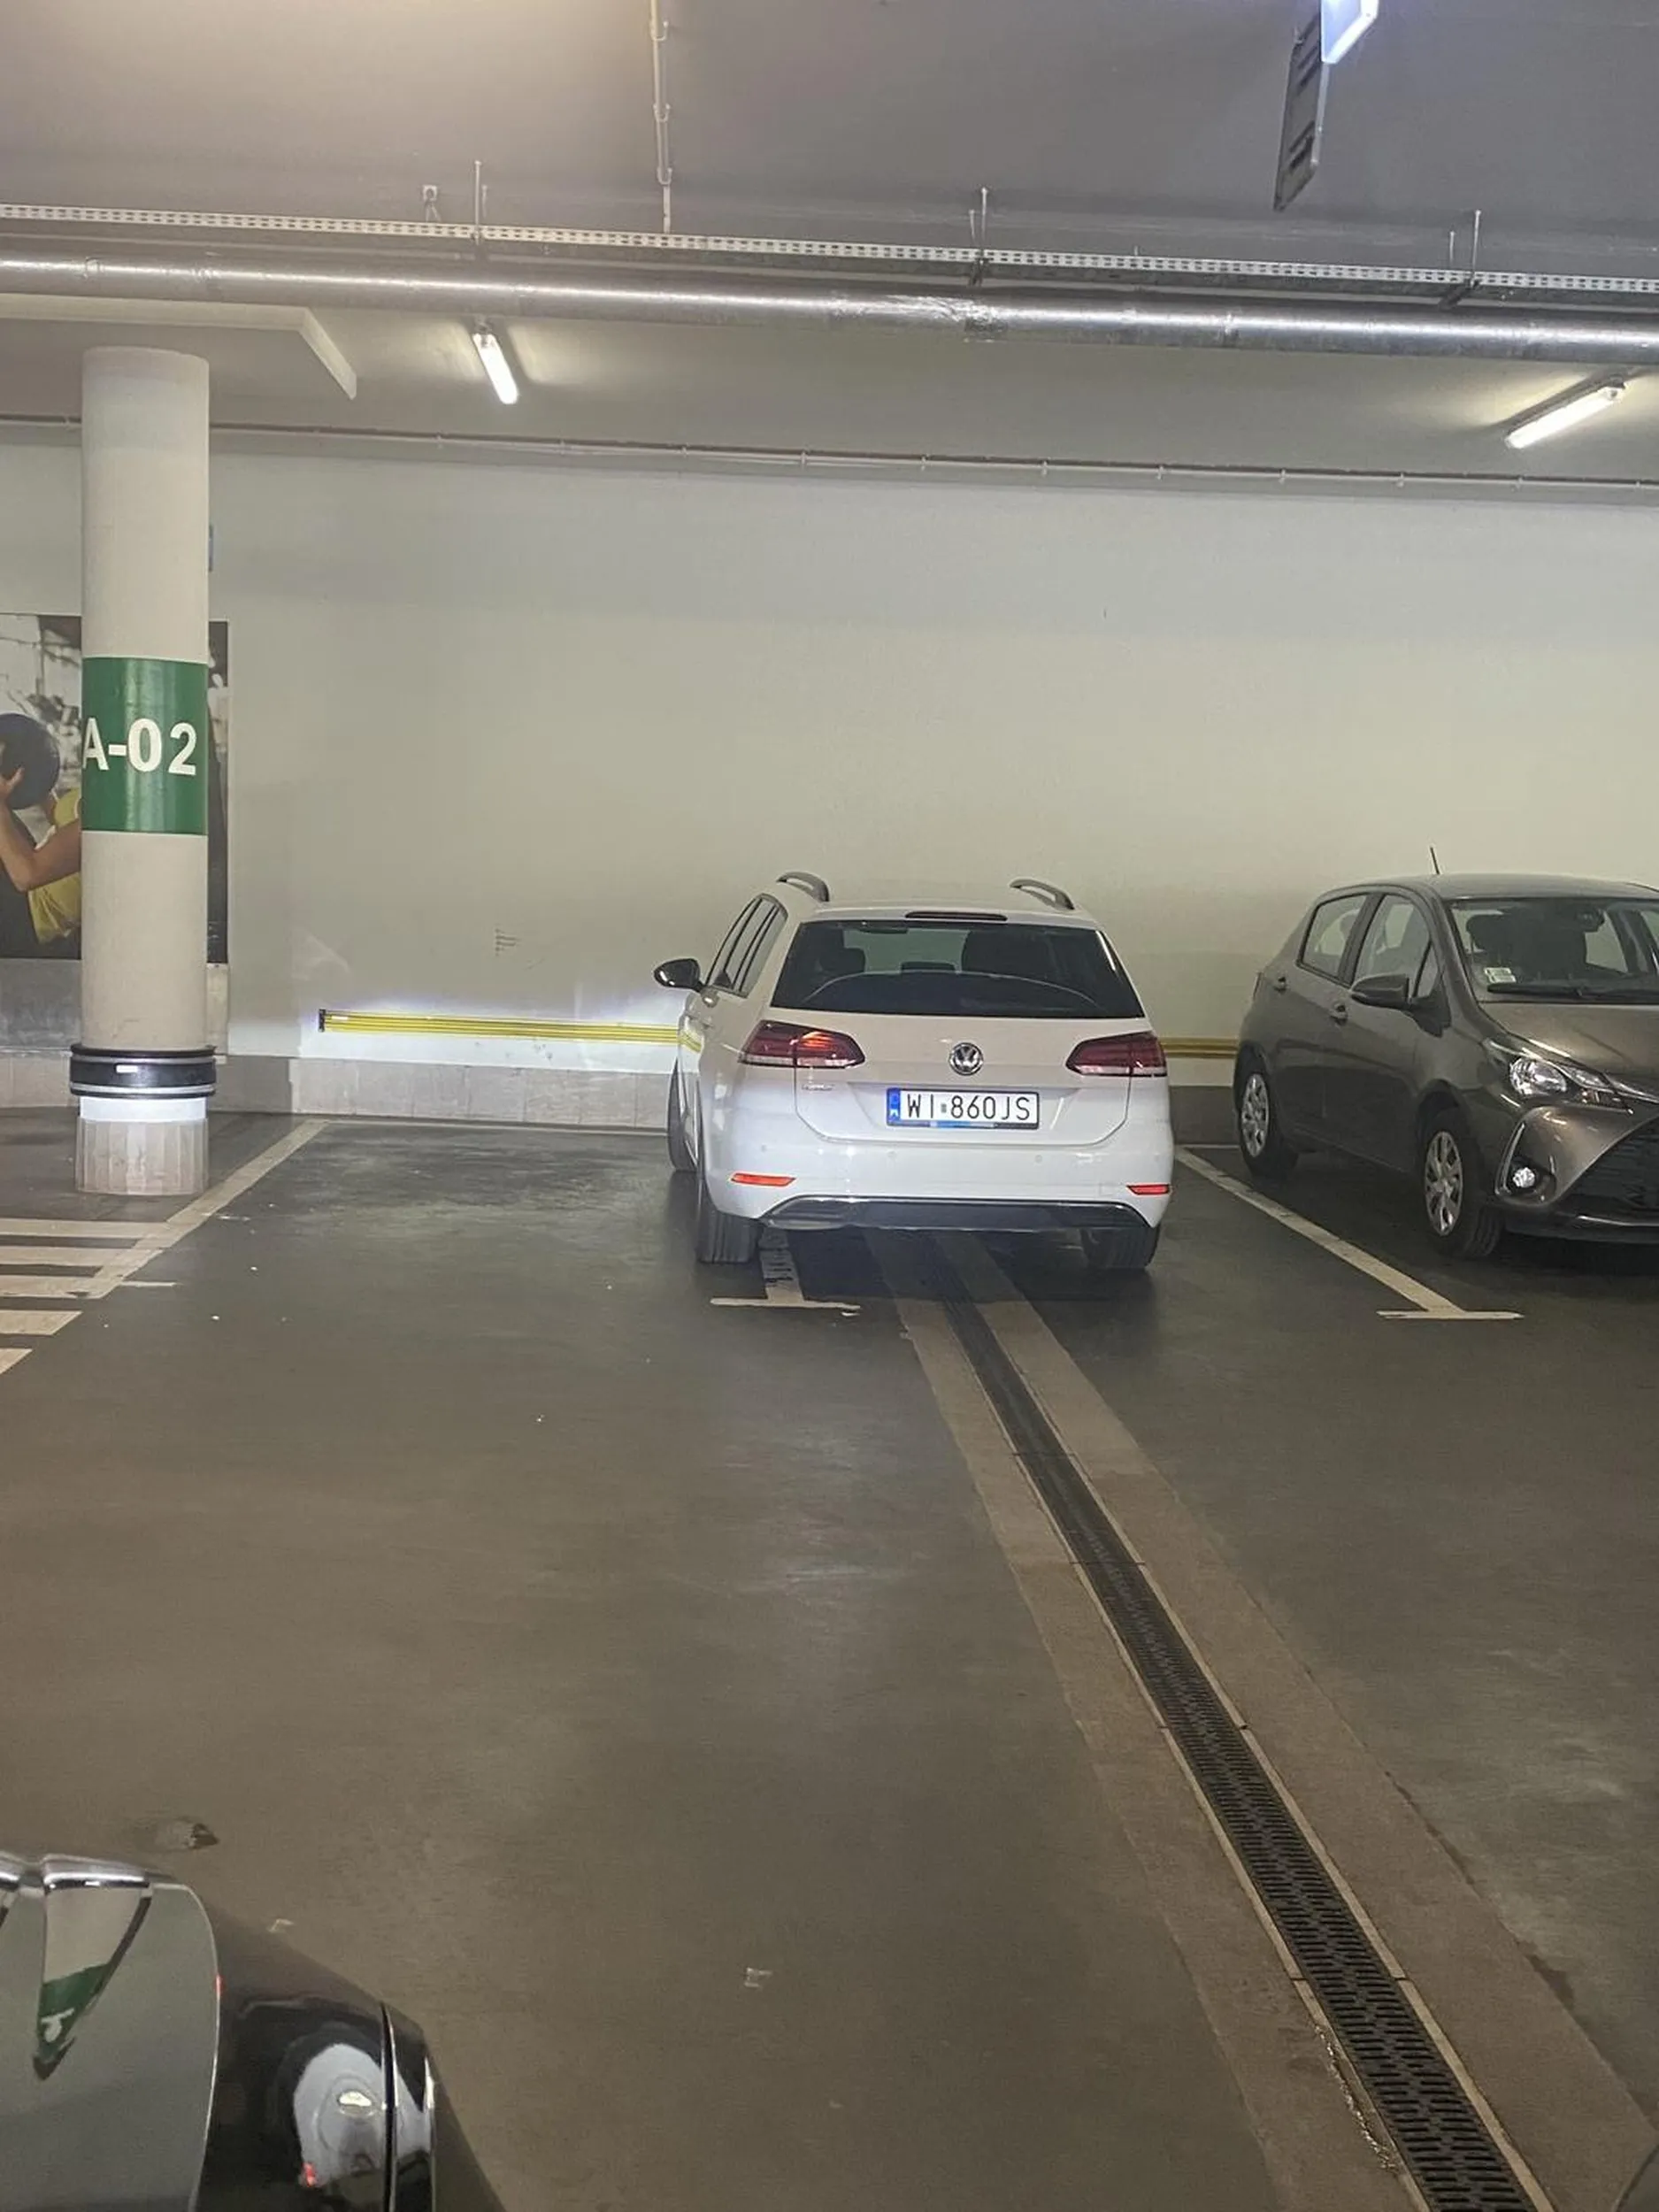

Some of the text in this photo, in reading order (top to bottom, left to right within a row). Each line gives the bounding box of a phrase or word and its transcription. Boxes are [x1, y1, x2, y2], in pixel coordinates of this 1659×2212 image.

[81, 717, 197, 776] A-02
[907, 1094, 1031, 1121] WI 860JS
